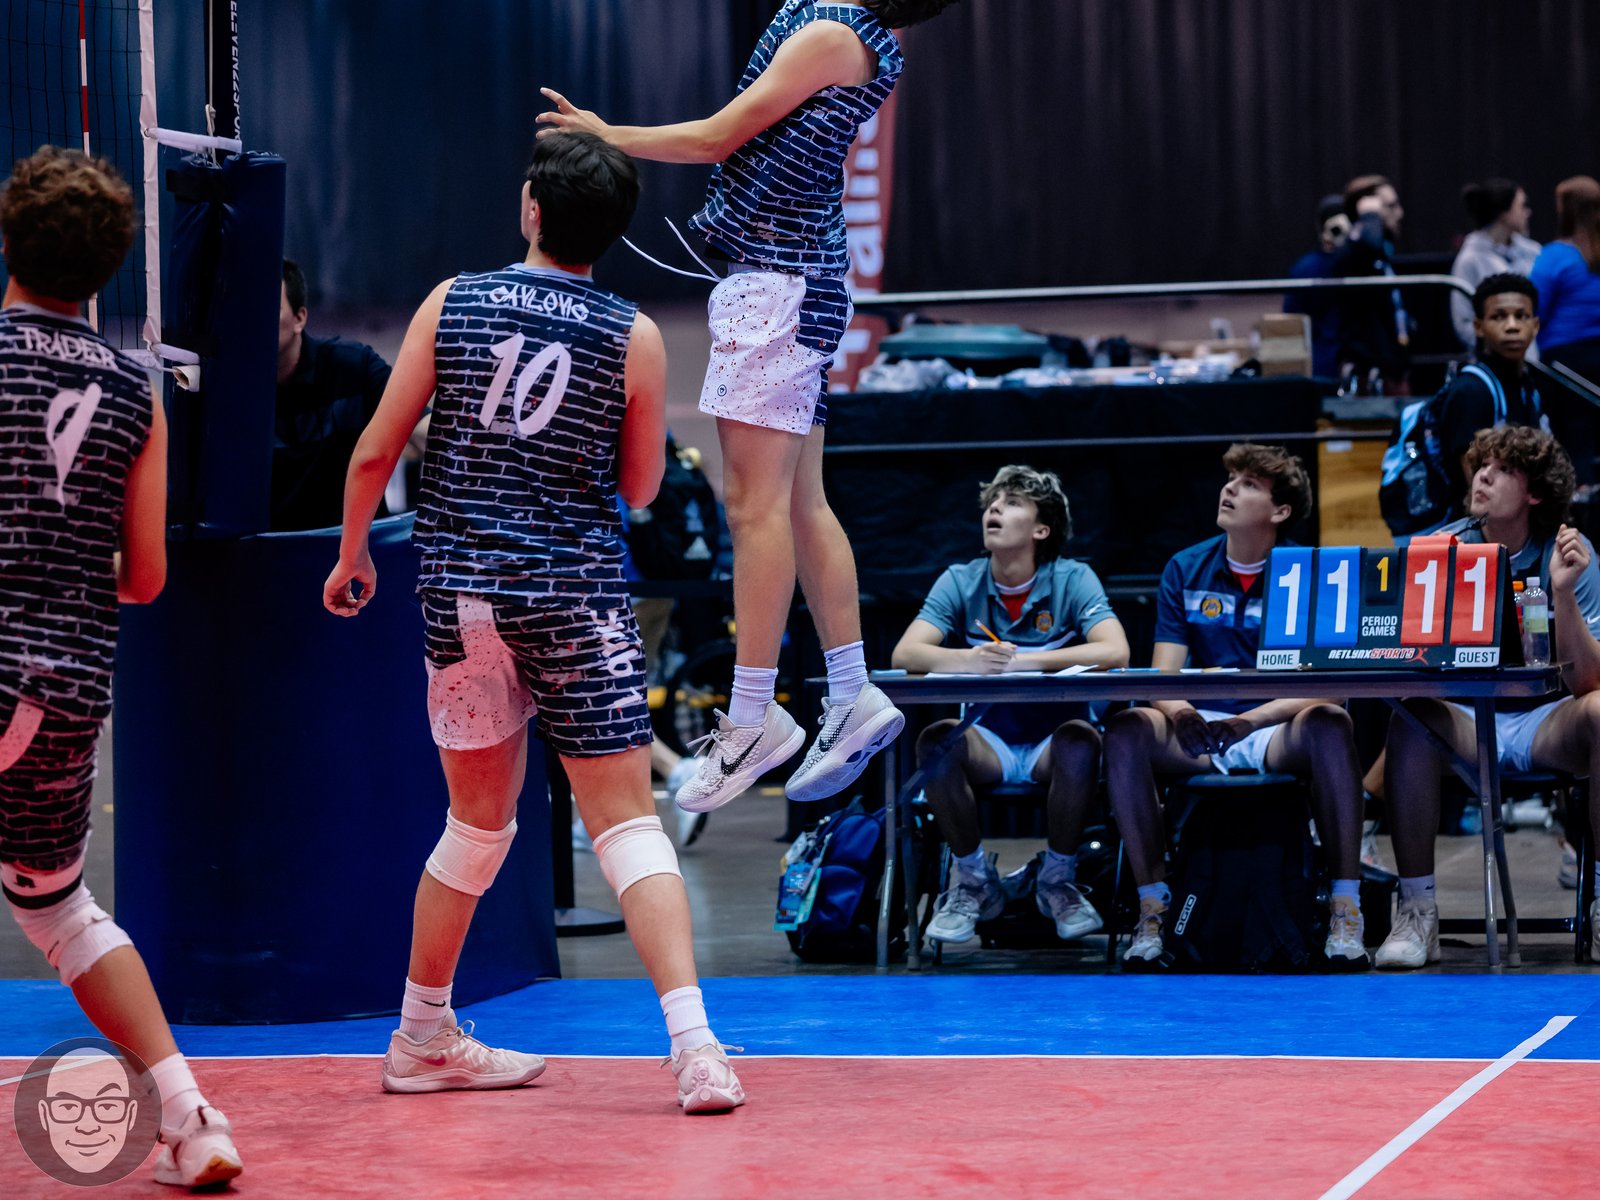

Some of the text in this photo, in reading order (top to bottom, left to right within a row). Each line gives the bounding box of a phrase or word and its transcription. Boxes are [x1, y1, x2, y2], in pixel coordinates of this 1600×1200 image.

[16, 326, 119, 369] TRADER
[479, 332, 572, 436] 10
[46, 382, 103, 504] 9
[1376, 556, 1389, 592] 1
[1361, 615, 1398, 627] PERIOD
[1361, 626, 1396, 637] GAMES
[1261, 652, 1294, 666] HOME
[1458, 650, 1497, 664] GUEST
[1174, 894, 1197, 935] OGIO
